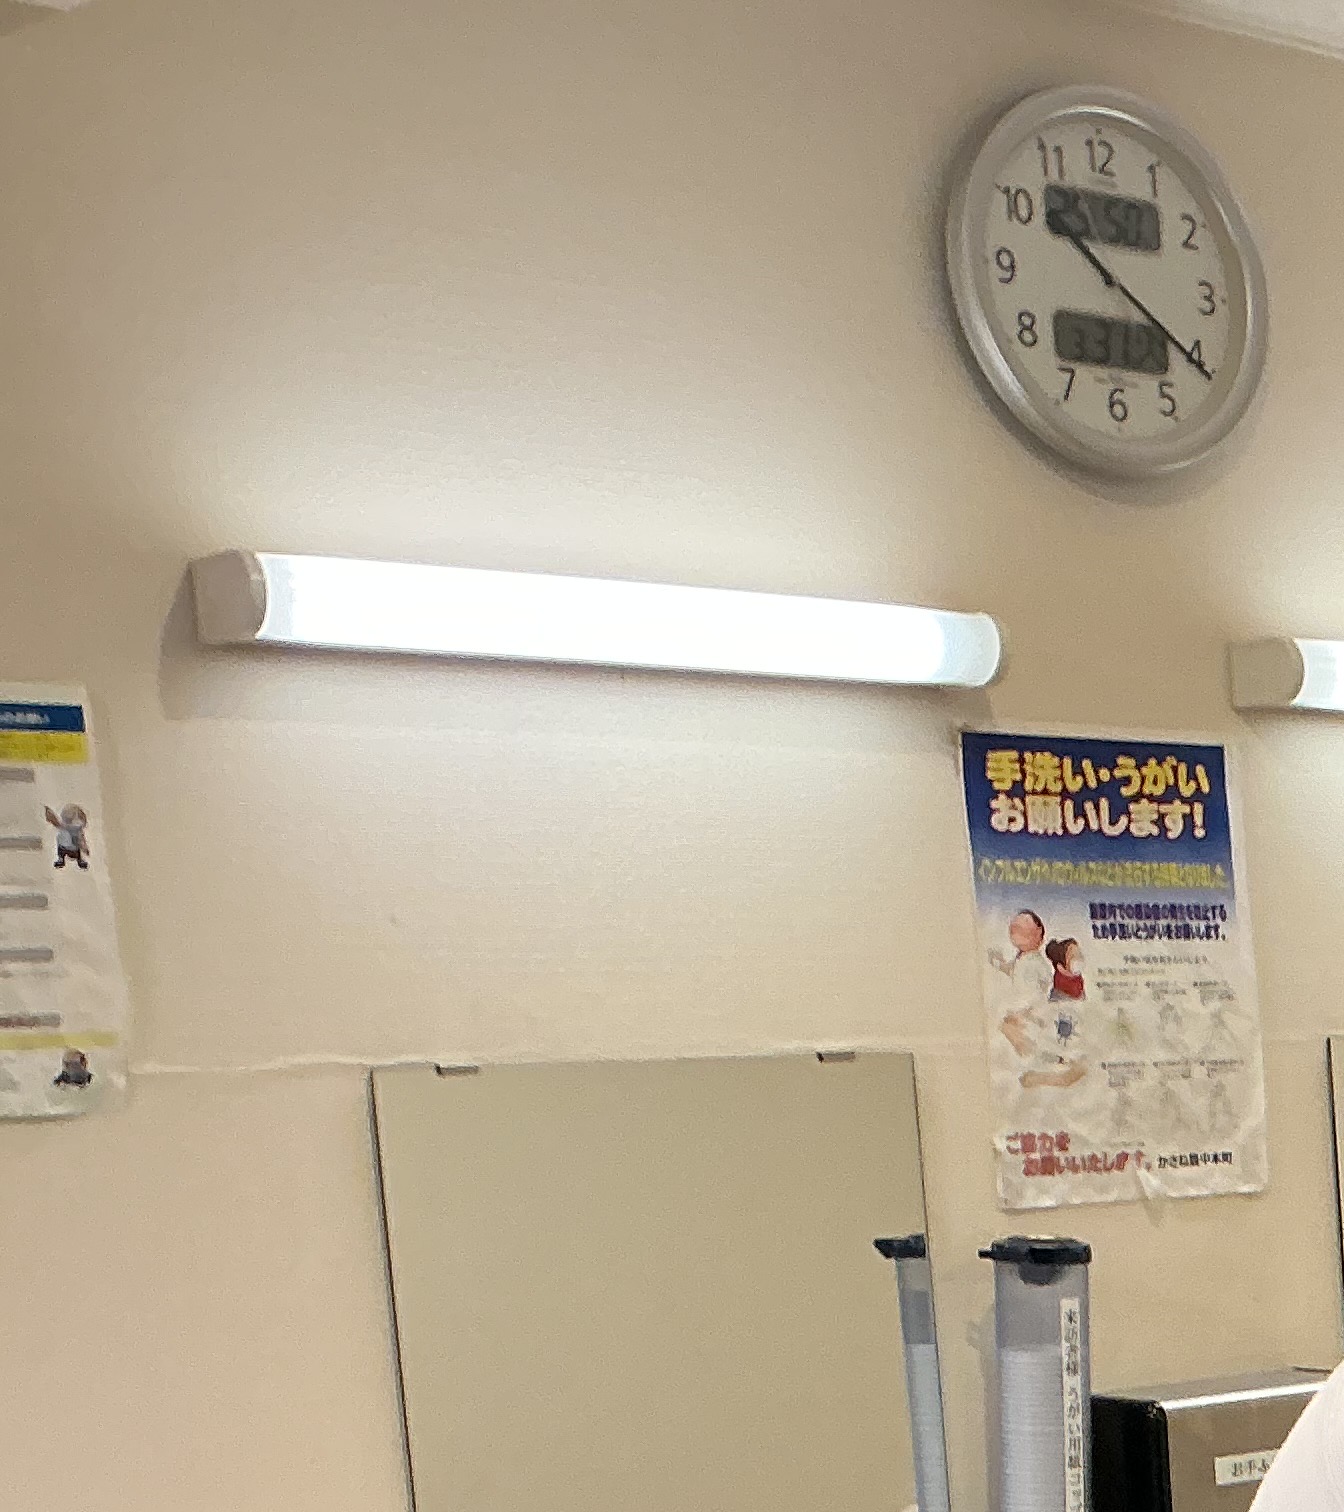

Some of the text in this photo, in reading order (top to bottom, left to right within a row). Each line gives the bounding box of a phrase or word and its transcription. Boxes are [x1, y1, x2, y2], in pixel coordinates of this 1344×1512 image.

[1037, 136, 1065, 180] 11
[1085, 138, 1116, 177] 12
[1147, 160, 1162, 199] 1
[996, 183, 1034, 226] 10
[1180, 213, 1200, 251] 2
[994, 246, 1017, 285] 9
[1197, 279, 1217, 316] 3
[1016, 310, 1039, 348] 8
[1057, 366, 1077, 401] 7
[1158, 380, 1177, 418] 5
[1107, 387, 1129, 423] 6
[985, 749, 1212, 799] 手洗い・うがい
